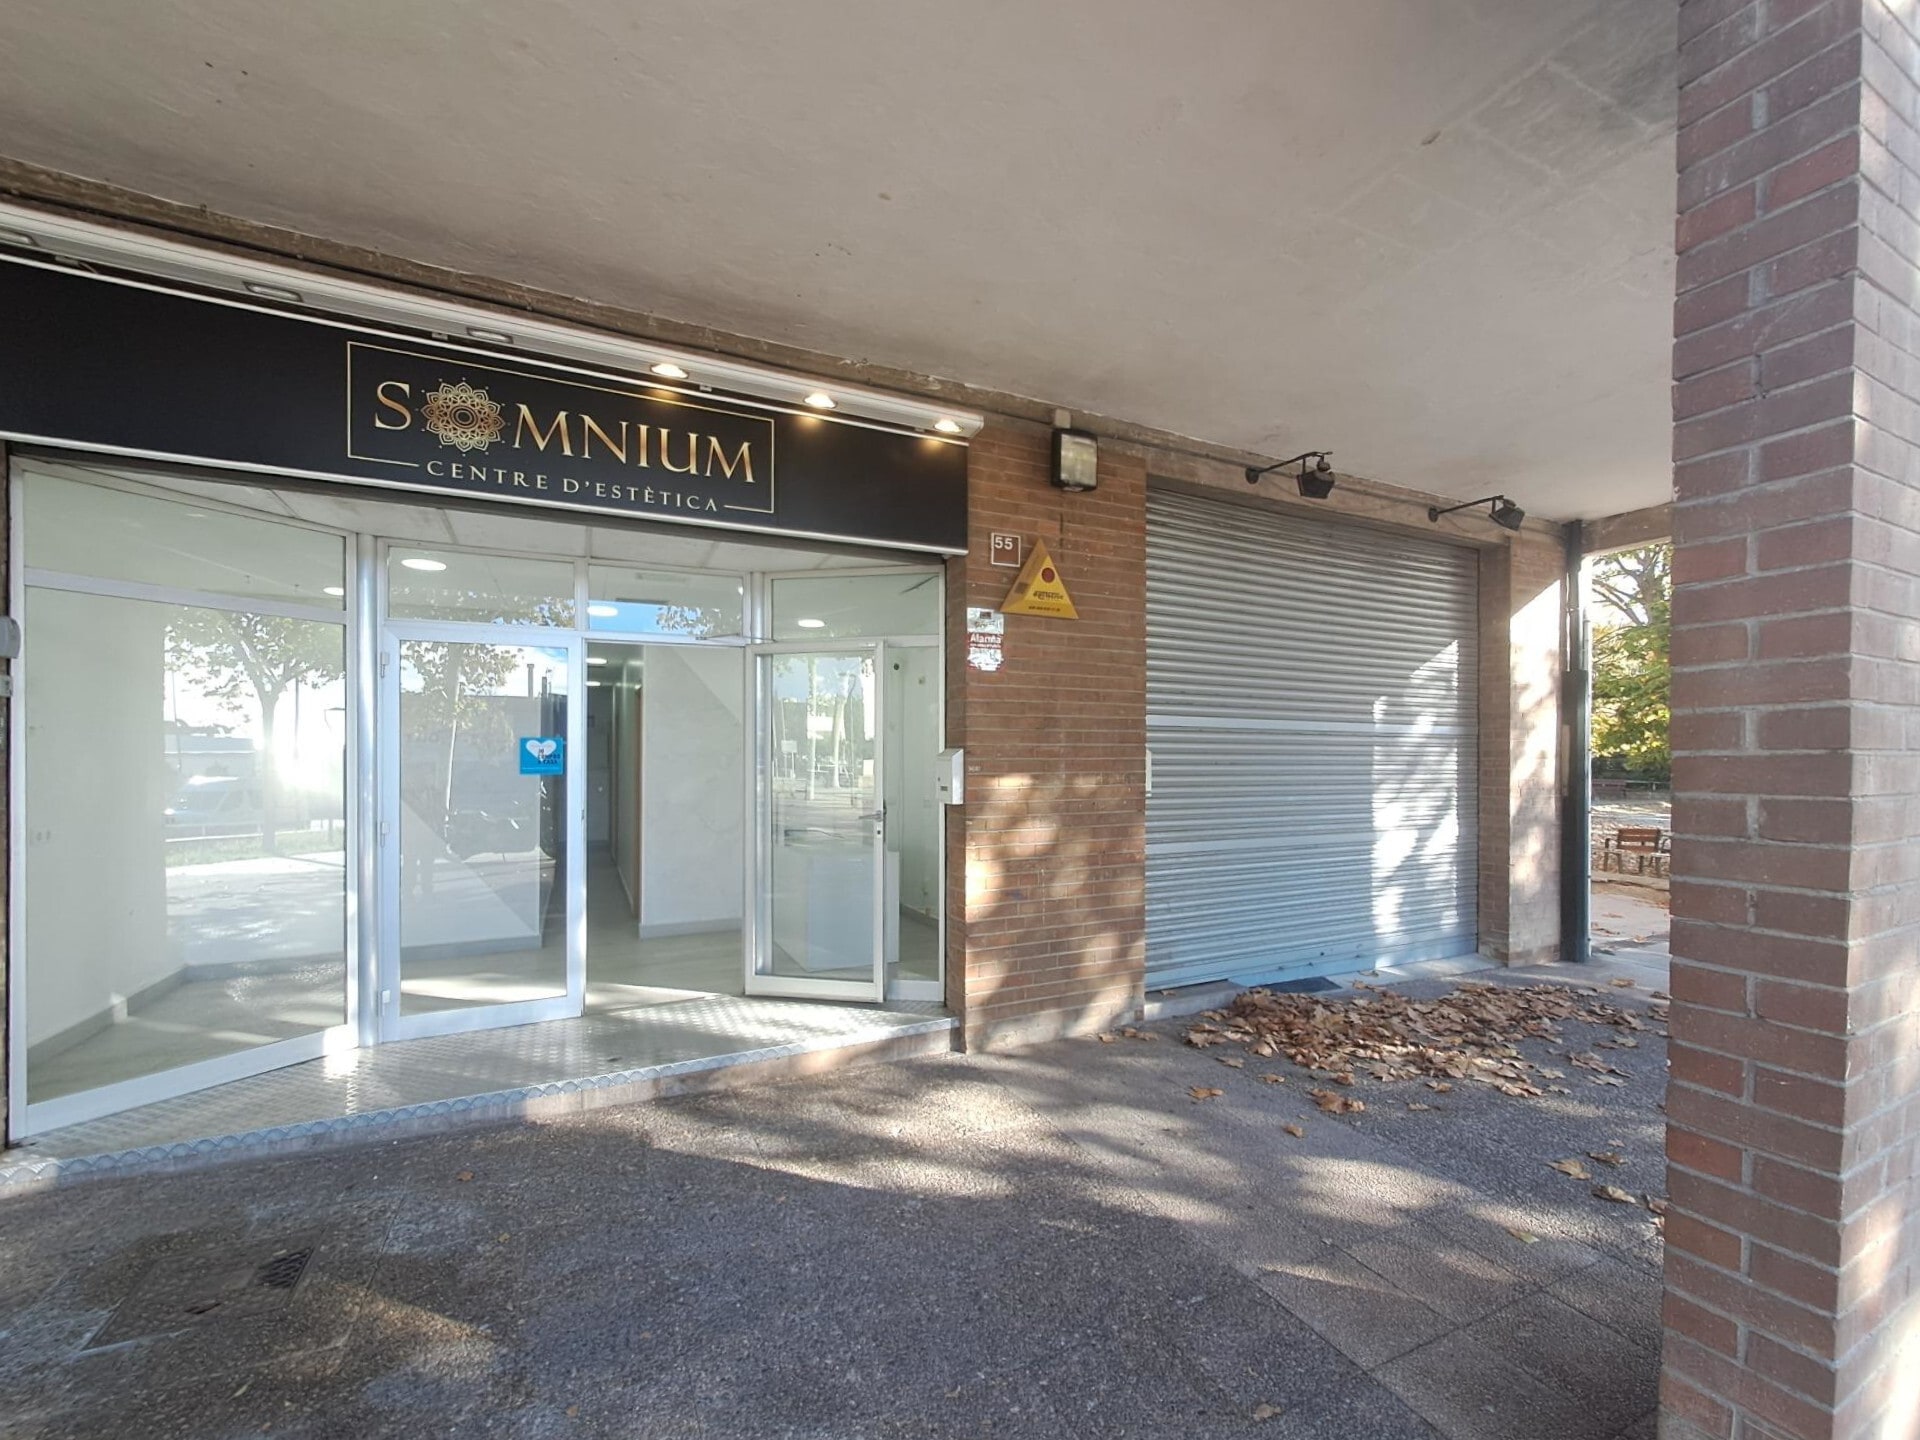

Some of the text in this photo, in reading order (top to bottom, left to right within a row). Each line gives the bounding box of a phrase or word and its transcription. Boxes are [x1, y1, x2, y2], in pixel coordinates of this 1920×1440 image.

[426, 459, 718, 512] CENTRE D'ESTÈTICA
[994, 536, 1013, 550] 55
